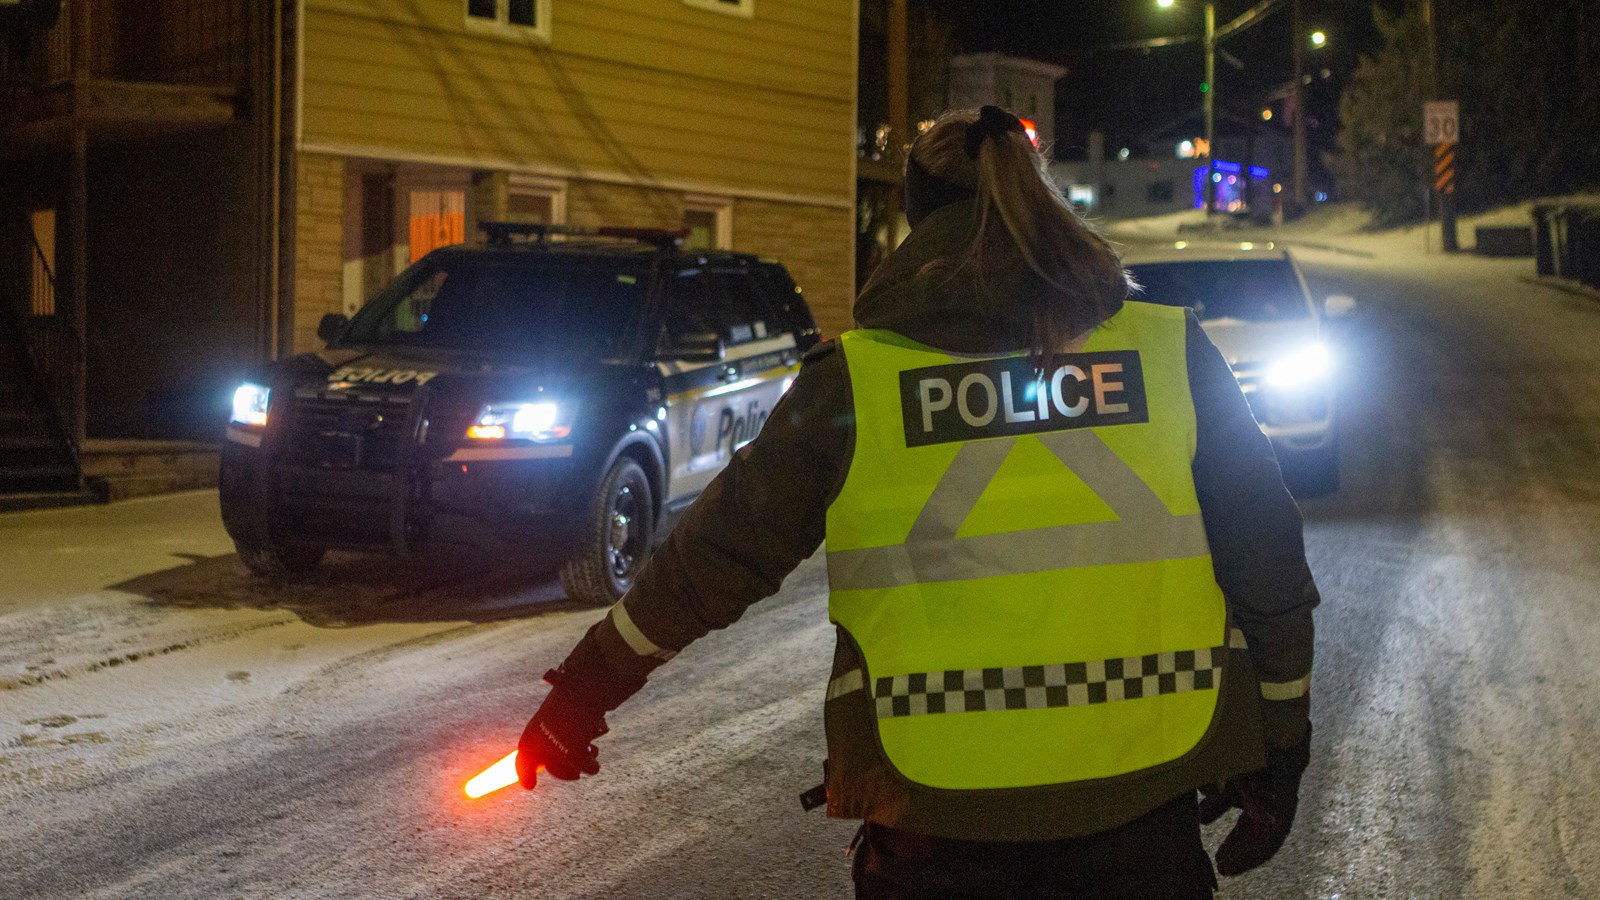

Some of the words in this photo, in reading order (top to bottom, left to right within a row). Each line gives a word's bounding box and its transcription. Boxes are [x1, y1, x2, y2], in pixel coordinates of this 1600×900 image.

[1429, 116, 1456, 138] 30
[919, 363, 1129, 433] POLICE
[716, 400, 768, 457] Polic
